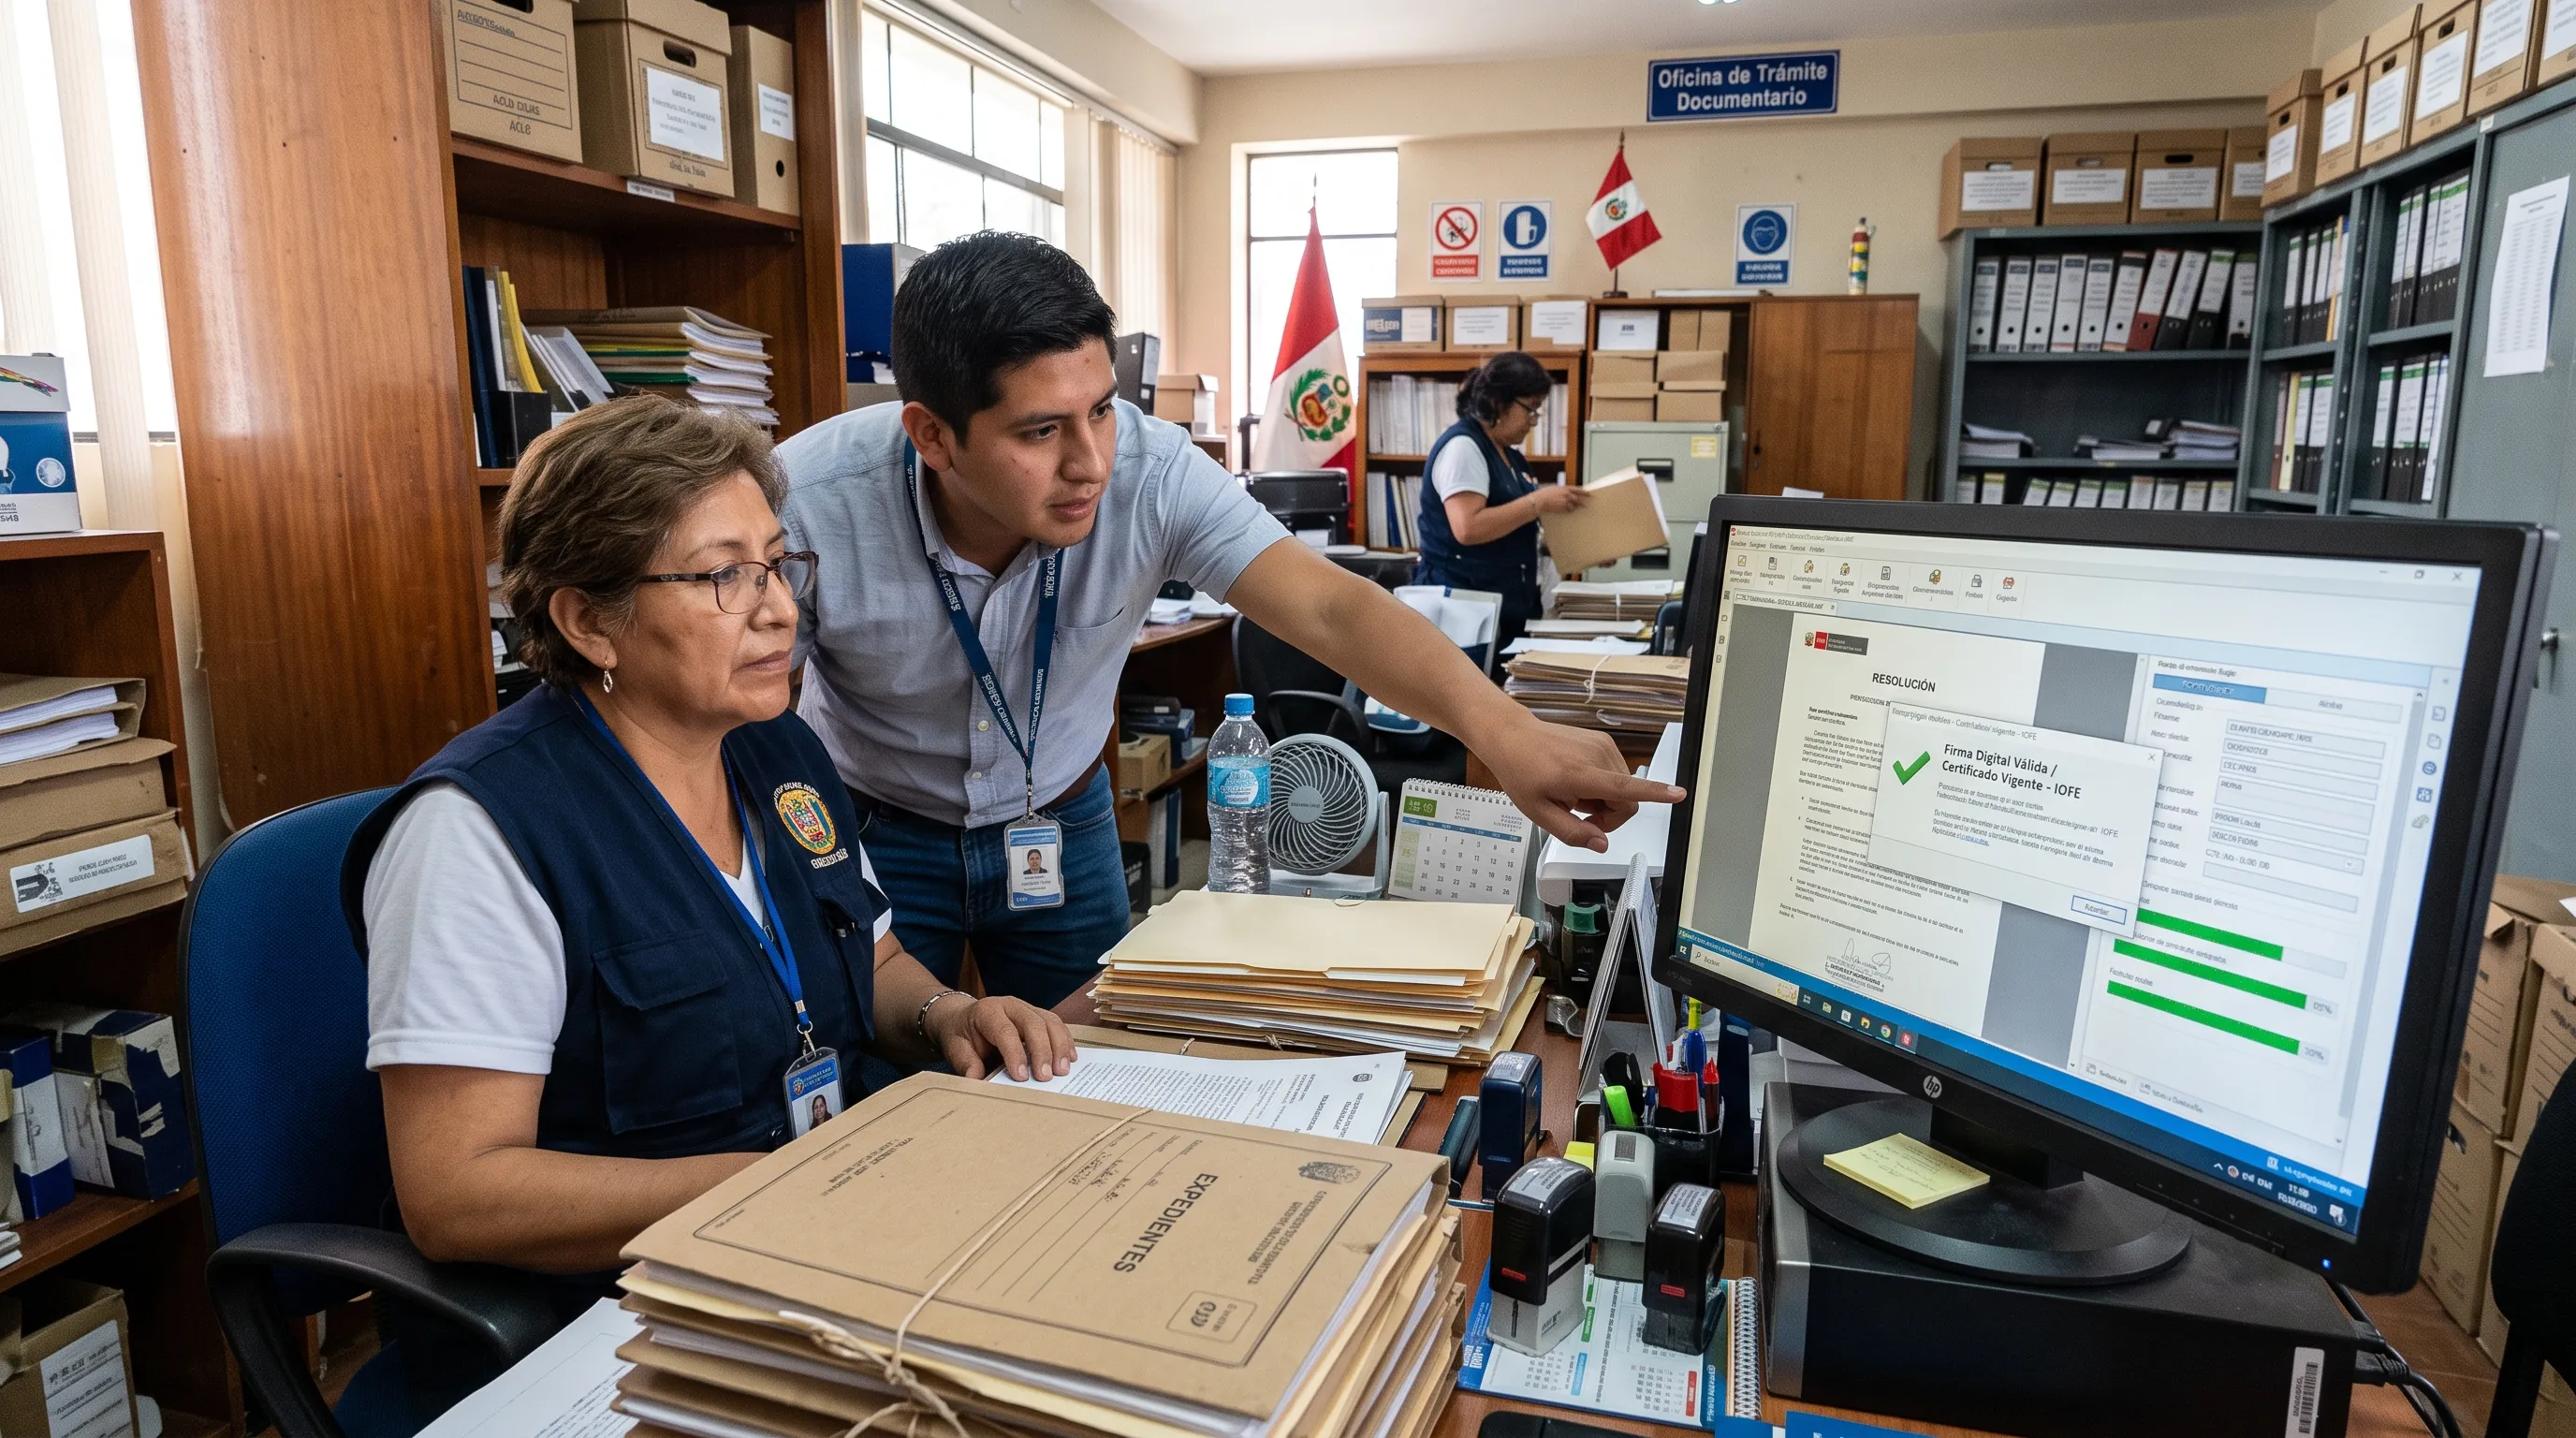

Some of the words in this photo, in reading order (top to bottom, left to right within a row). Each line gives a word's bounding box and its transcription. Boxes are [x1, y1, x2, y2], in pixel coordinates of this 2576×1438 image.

[1658, 67, 1723, 89] Oficina
[1728, 66, 1751, 85] de
[1756, 61, 1828, 83] Trámite
[1676, 87, 1808, 111] Documentario
[1871, 672, 1937, 693] RESOLUCIÓN
[1943, 743, 1973, 759] Firma
[1975, 749, 2012, 767] Digital
[2013, 756, 2049, 774] Válida
[2050, 764, 2058, 778] /
[1941, 760, 1998, 782] Certificado
[2001, 771, 2043, 791] Vigente
[2054, 783, 2082, 800] IOFE
[2100, 826, 2119, 839] IOFE
[1925, 1076, 1941, 1098] hp
[1113, 1173, 1219, 1273] EXPEDIENTES
